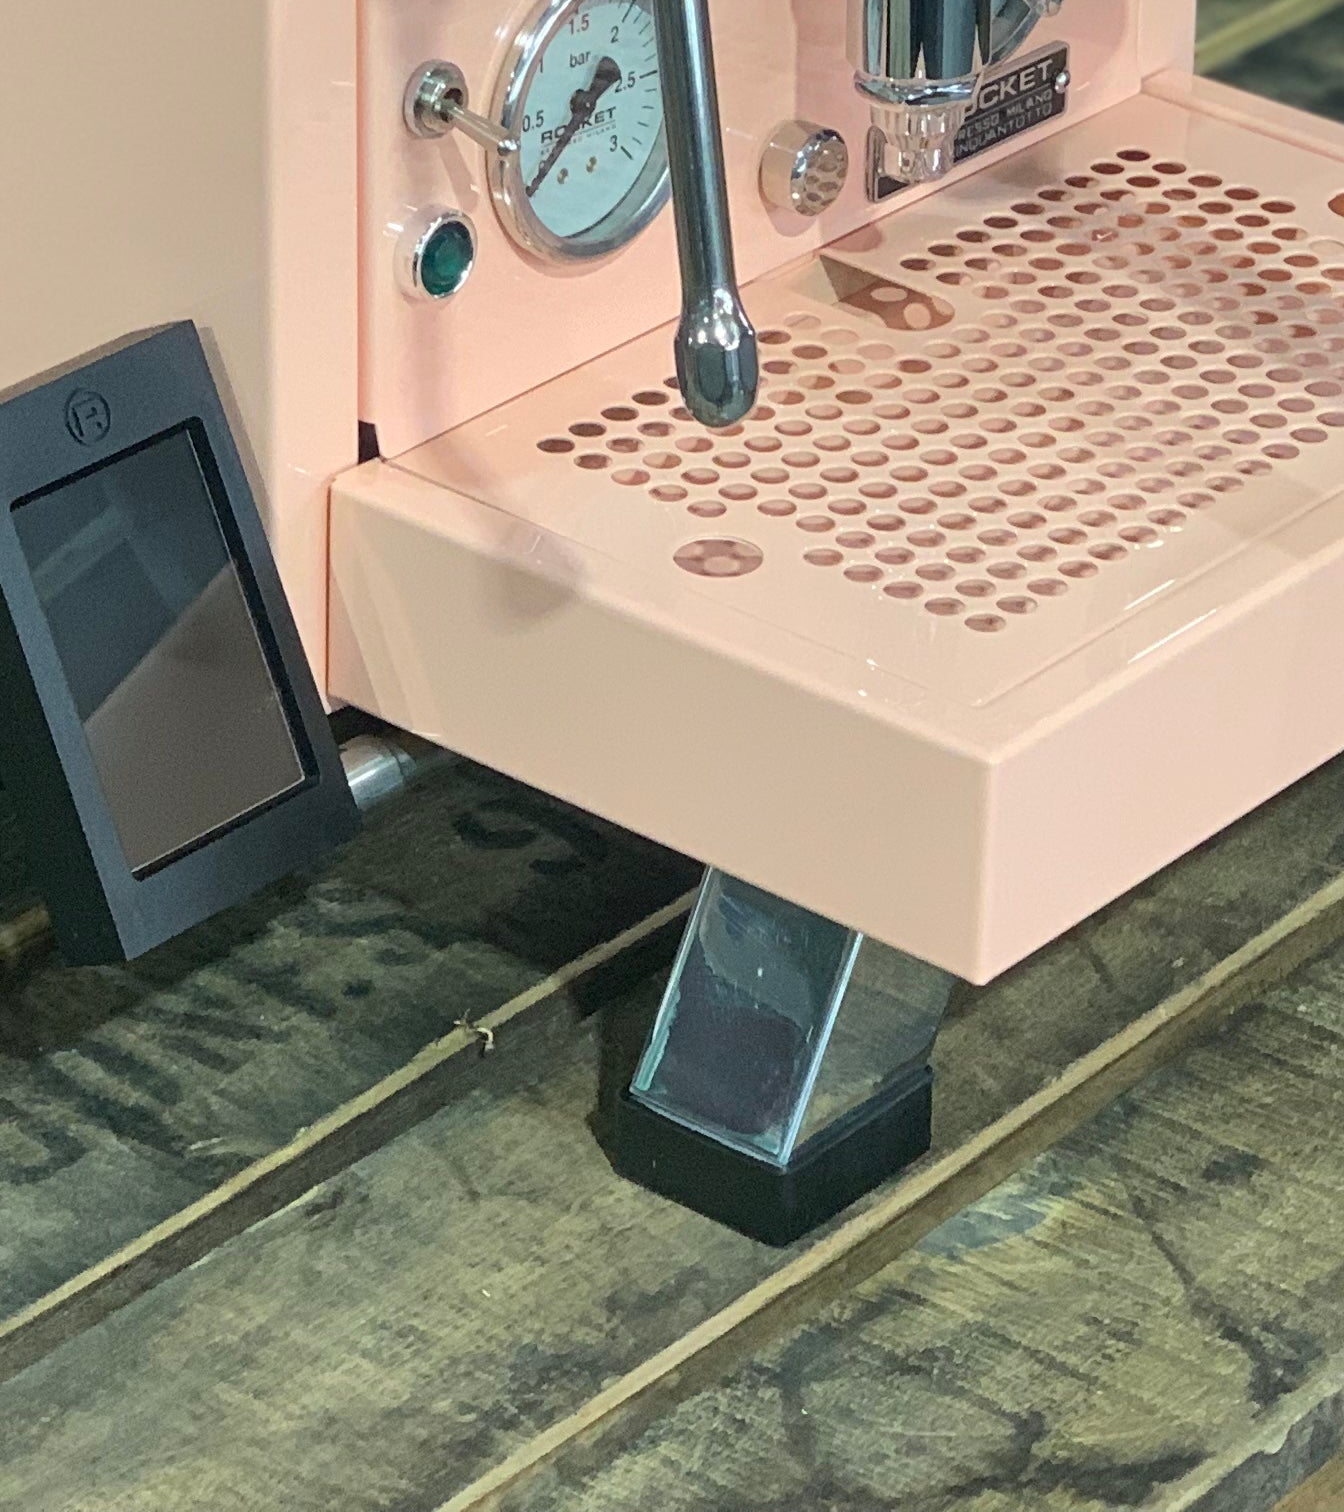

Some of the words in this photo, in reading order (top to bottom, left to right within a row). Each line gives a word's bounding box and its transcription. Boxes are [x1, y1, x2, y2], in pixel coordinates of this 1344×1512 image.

[569, 13, 591, 36] 1.5
[610, 25, 620, 44] 2
[569, 50, 591, 68] bar
[614, 71, 636, 94] 2.5
[1006, 88, 1053, 117] MILANO
[522, 110, 545, 133] 0.5
[541, 106, 617, 145] ROKET
[609, 134, 619, 153] 3
